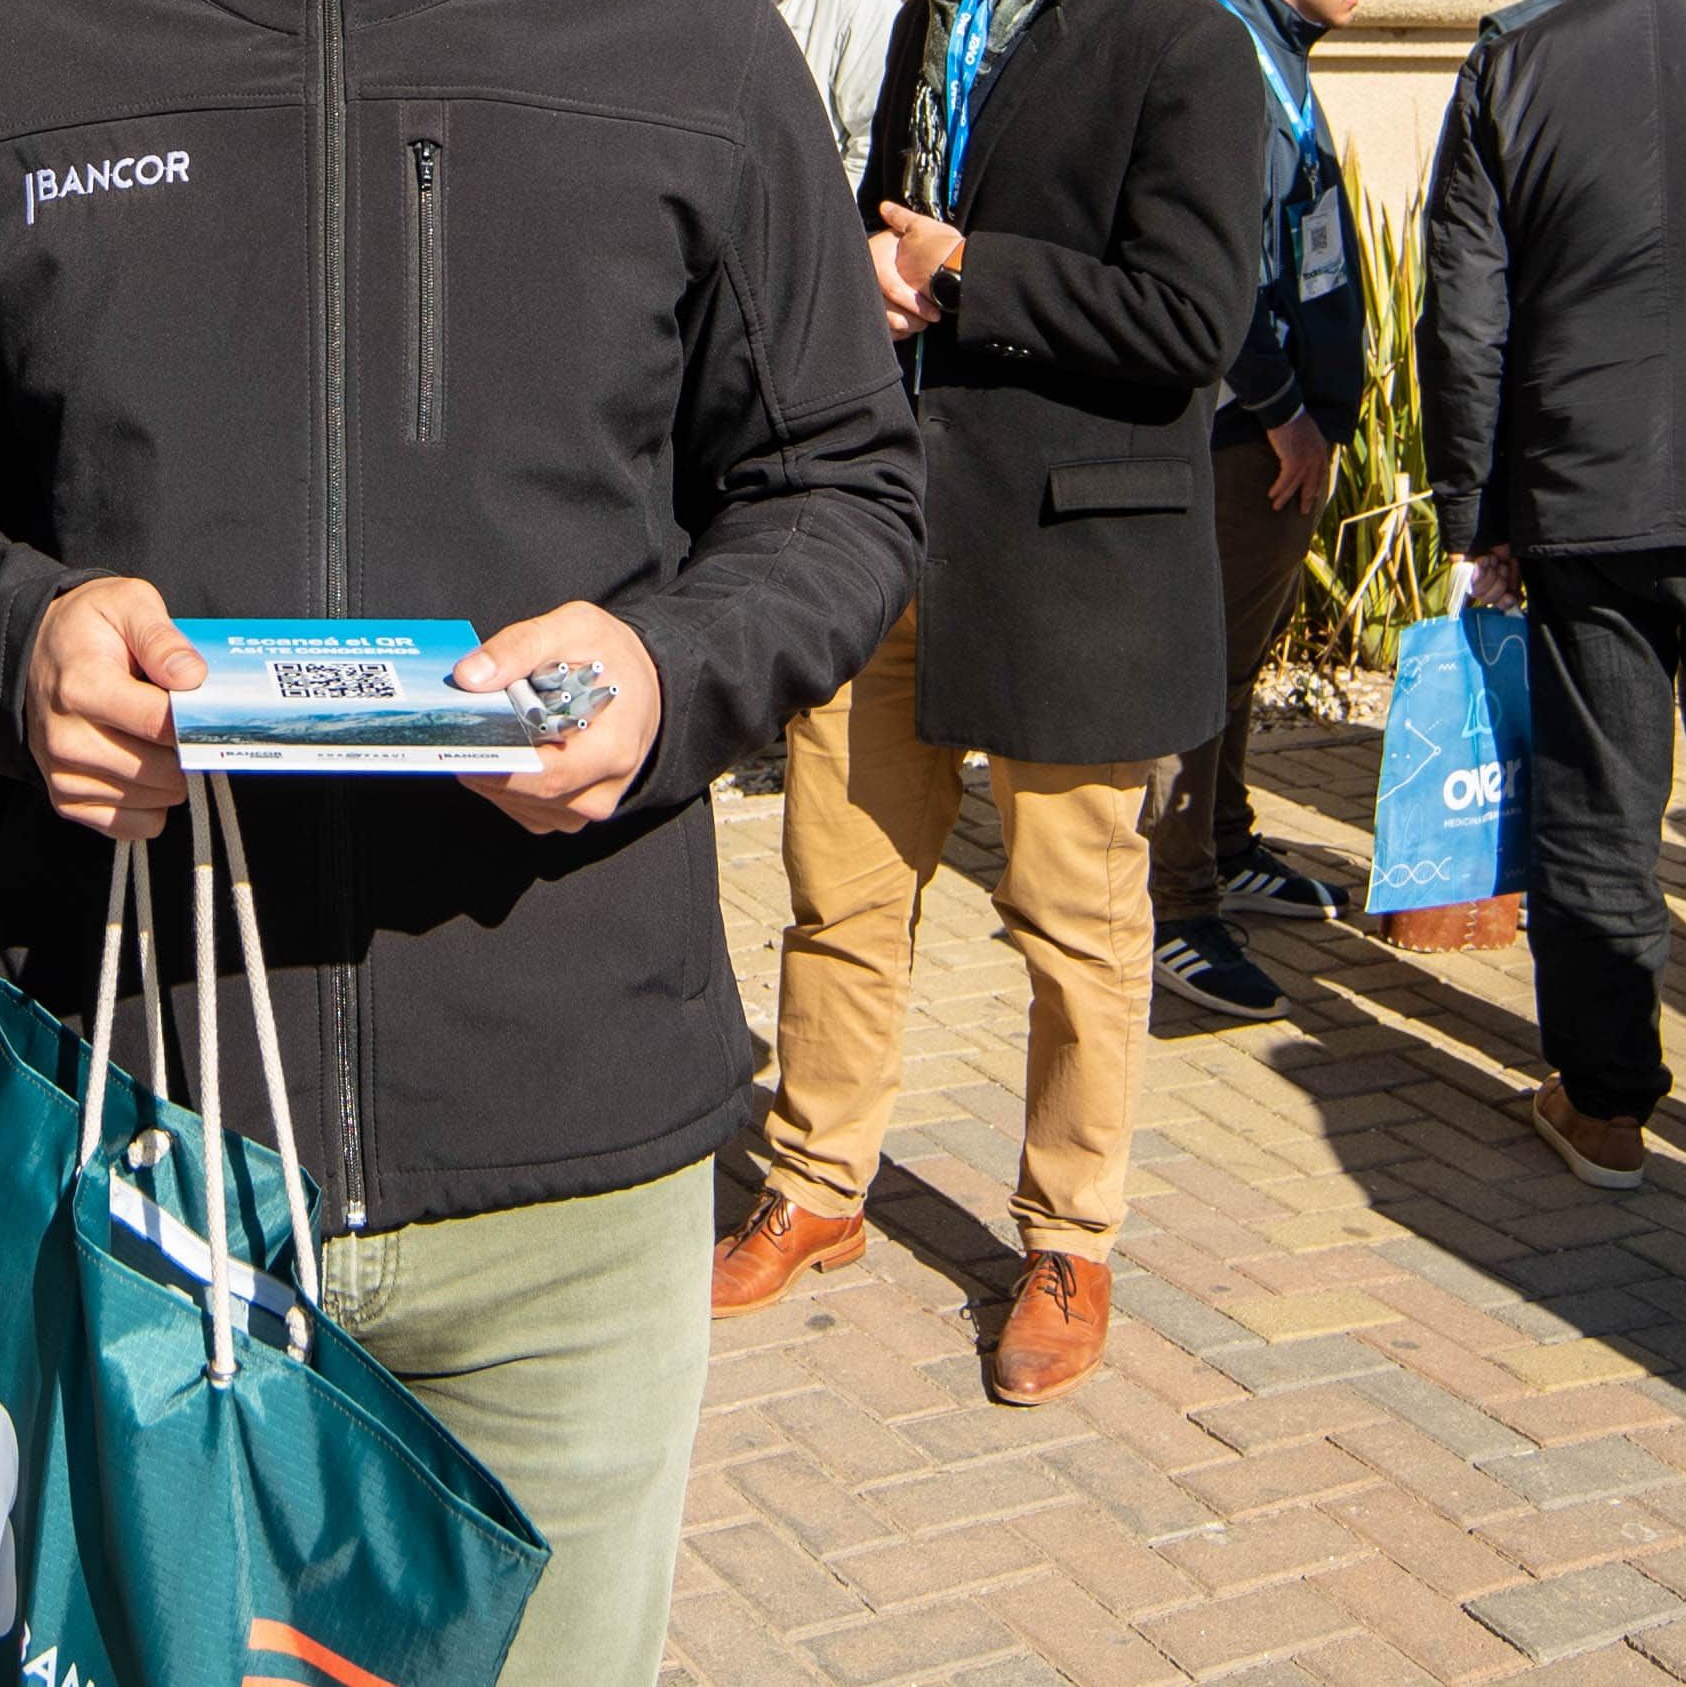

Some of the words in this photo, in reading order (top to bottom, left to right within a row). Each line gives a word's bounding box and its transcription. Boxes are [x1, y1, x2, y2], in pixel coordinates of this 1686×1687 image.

[35, 150, 190, 202] BANCOR
[295, 647, 421, 656] CONOCEMOS
[375, 637, 415, 647] QR
[1443, 758, 1522, 811] over
